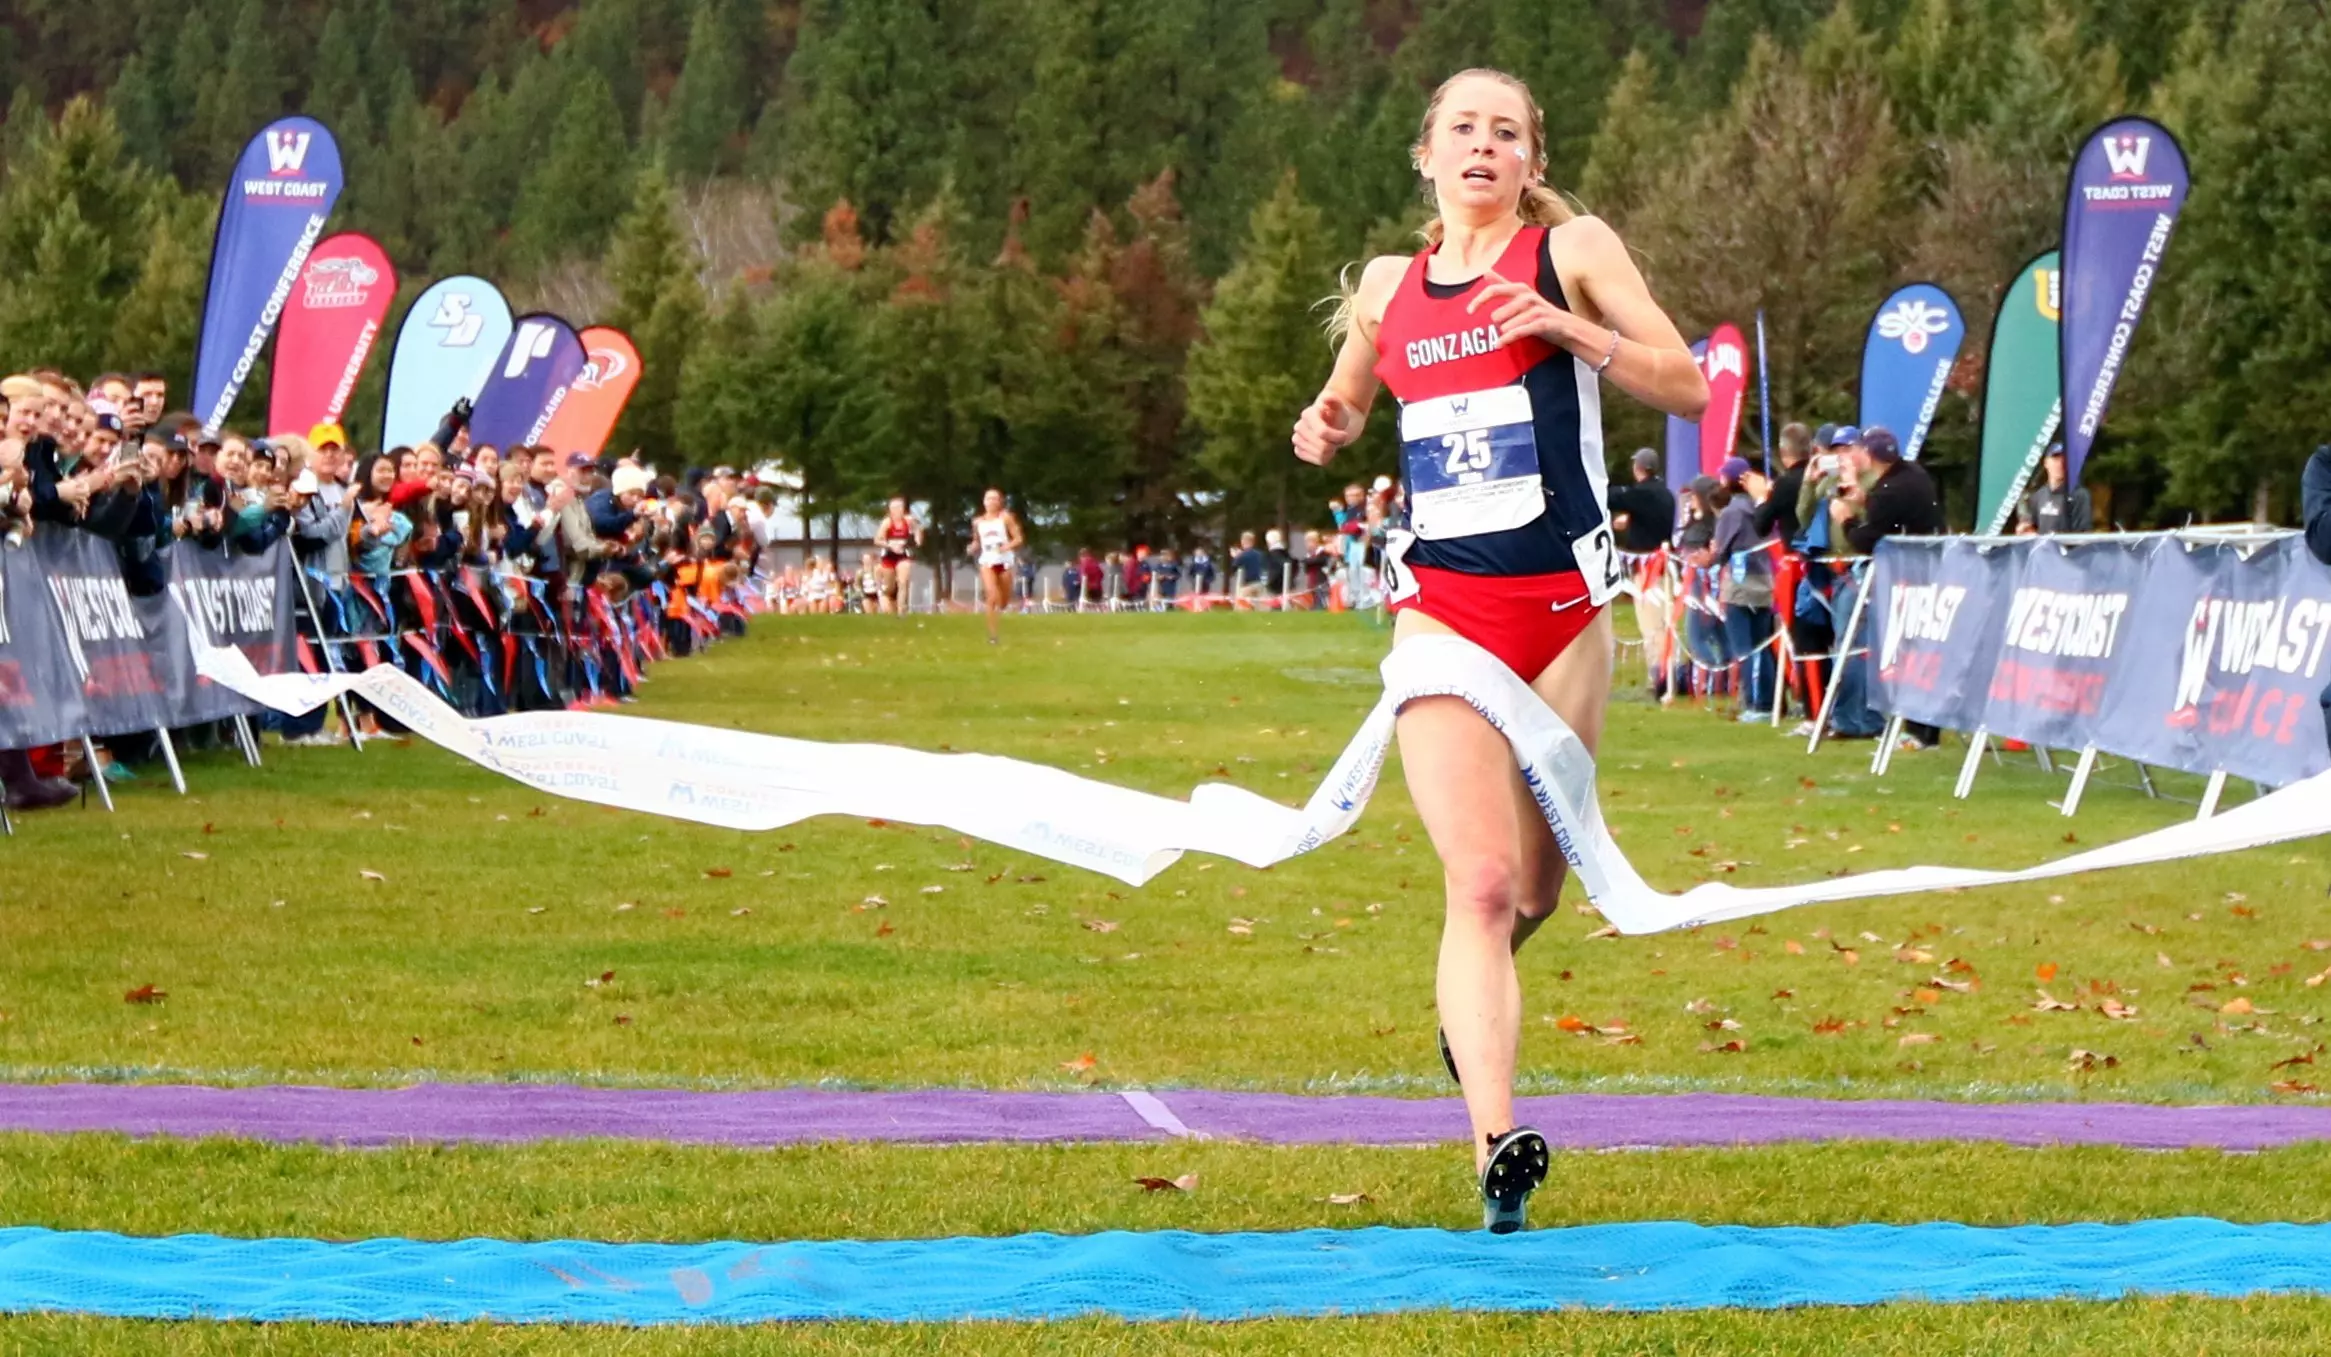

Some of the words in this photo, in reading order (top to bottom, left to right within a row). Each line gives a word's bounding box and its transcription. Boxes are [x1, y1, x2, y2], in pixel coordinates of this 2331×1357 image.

[266, 131, 311, 173] W
[244, 180, 283, 195] WEST
[284, 182, 327, 196] COAST
[201, 379, 239, 438] WEST
[232, 323, 269, 386] COAST
[261, 213, 326, 326] CONFERENCE
[1406, 324, 1500, 369] GONZAGA
[328, 318, 378, 414] UNIVERSITY
[1918, 356, 1953, 425] COLLEGE
[1441, 428, 1491, 474] 25
[1980, 466, 2031, 550] NIVERSITY
[2025, 444, 2043, 467] OF
[2036, 412, 2061, 445] SAN
[1594, 529, 1620, 590] 2
[1535, 783, 1563, 827] WEST
[1554, 826, 1584, 868] COAST
